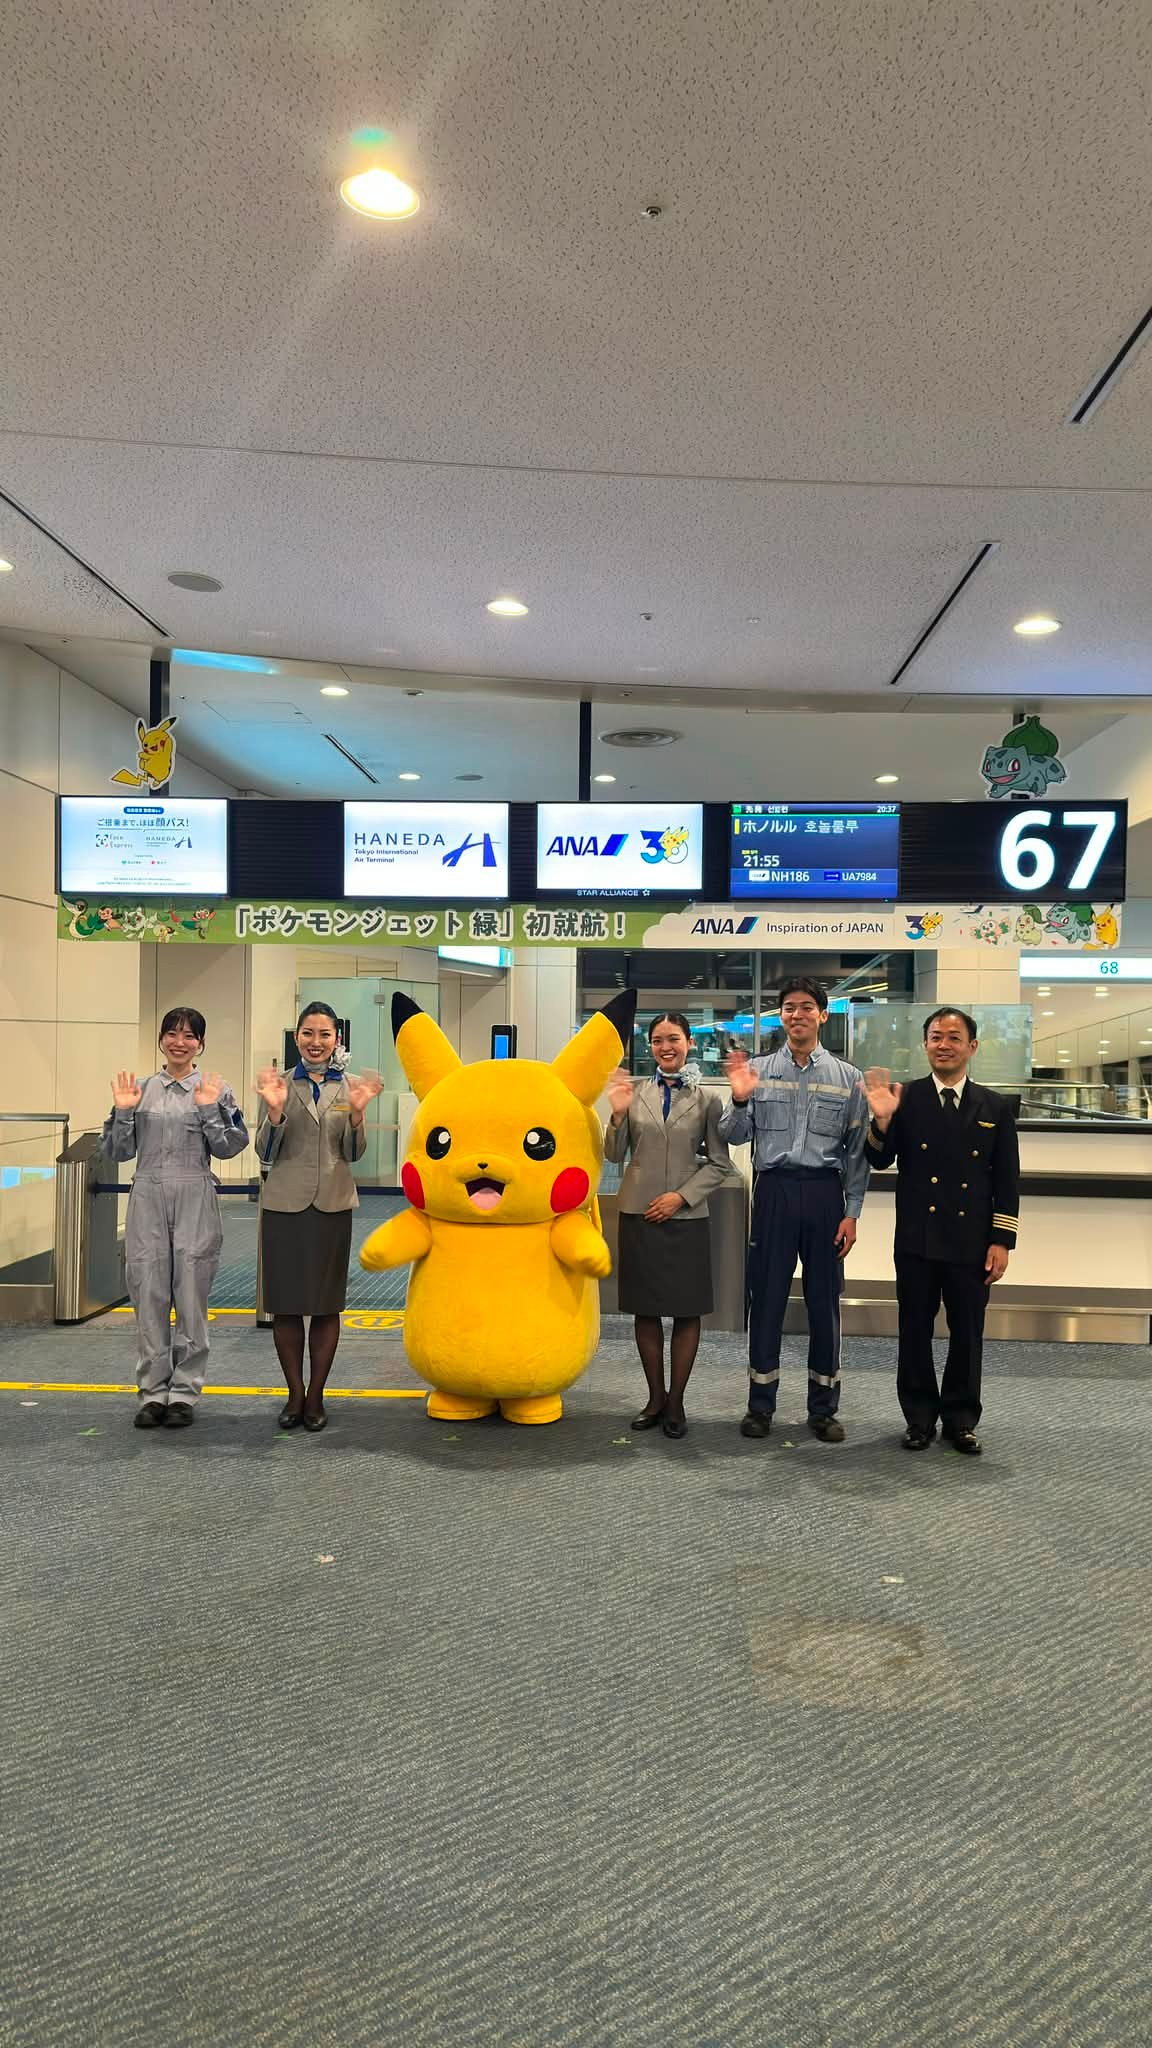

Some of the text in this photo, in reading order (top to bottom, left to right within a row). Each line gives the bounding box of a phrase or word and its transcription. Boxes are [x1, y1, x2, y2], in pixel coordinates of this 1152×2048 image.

[876, 805, 896, 813] 20:37
[743, 819, 797, 834] ホノルル
[804, 819, 859, 834] 호놀룰루
[354, 832, 446, 847] HANEDA
[546, 836, 599, 856] ANA
[354, 848, 419, 856] Tokyo International
[999, 810, 1117, 891] 67
[743, 855, 780, 868] 21:55
[771, 871, 810, 882] NH186
[842, 872, 877, 881] UA7984
[576, 889, 639, 897] STAR ALLIANCE
[691, 918, 735, 935] ANA
[767, 922, 884, 935] Inspiration of JAPAN
[1100, 961, 1119, 975] 68
